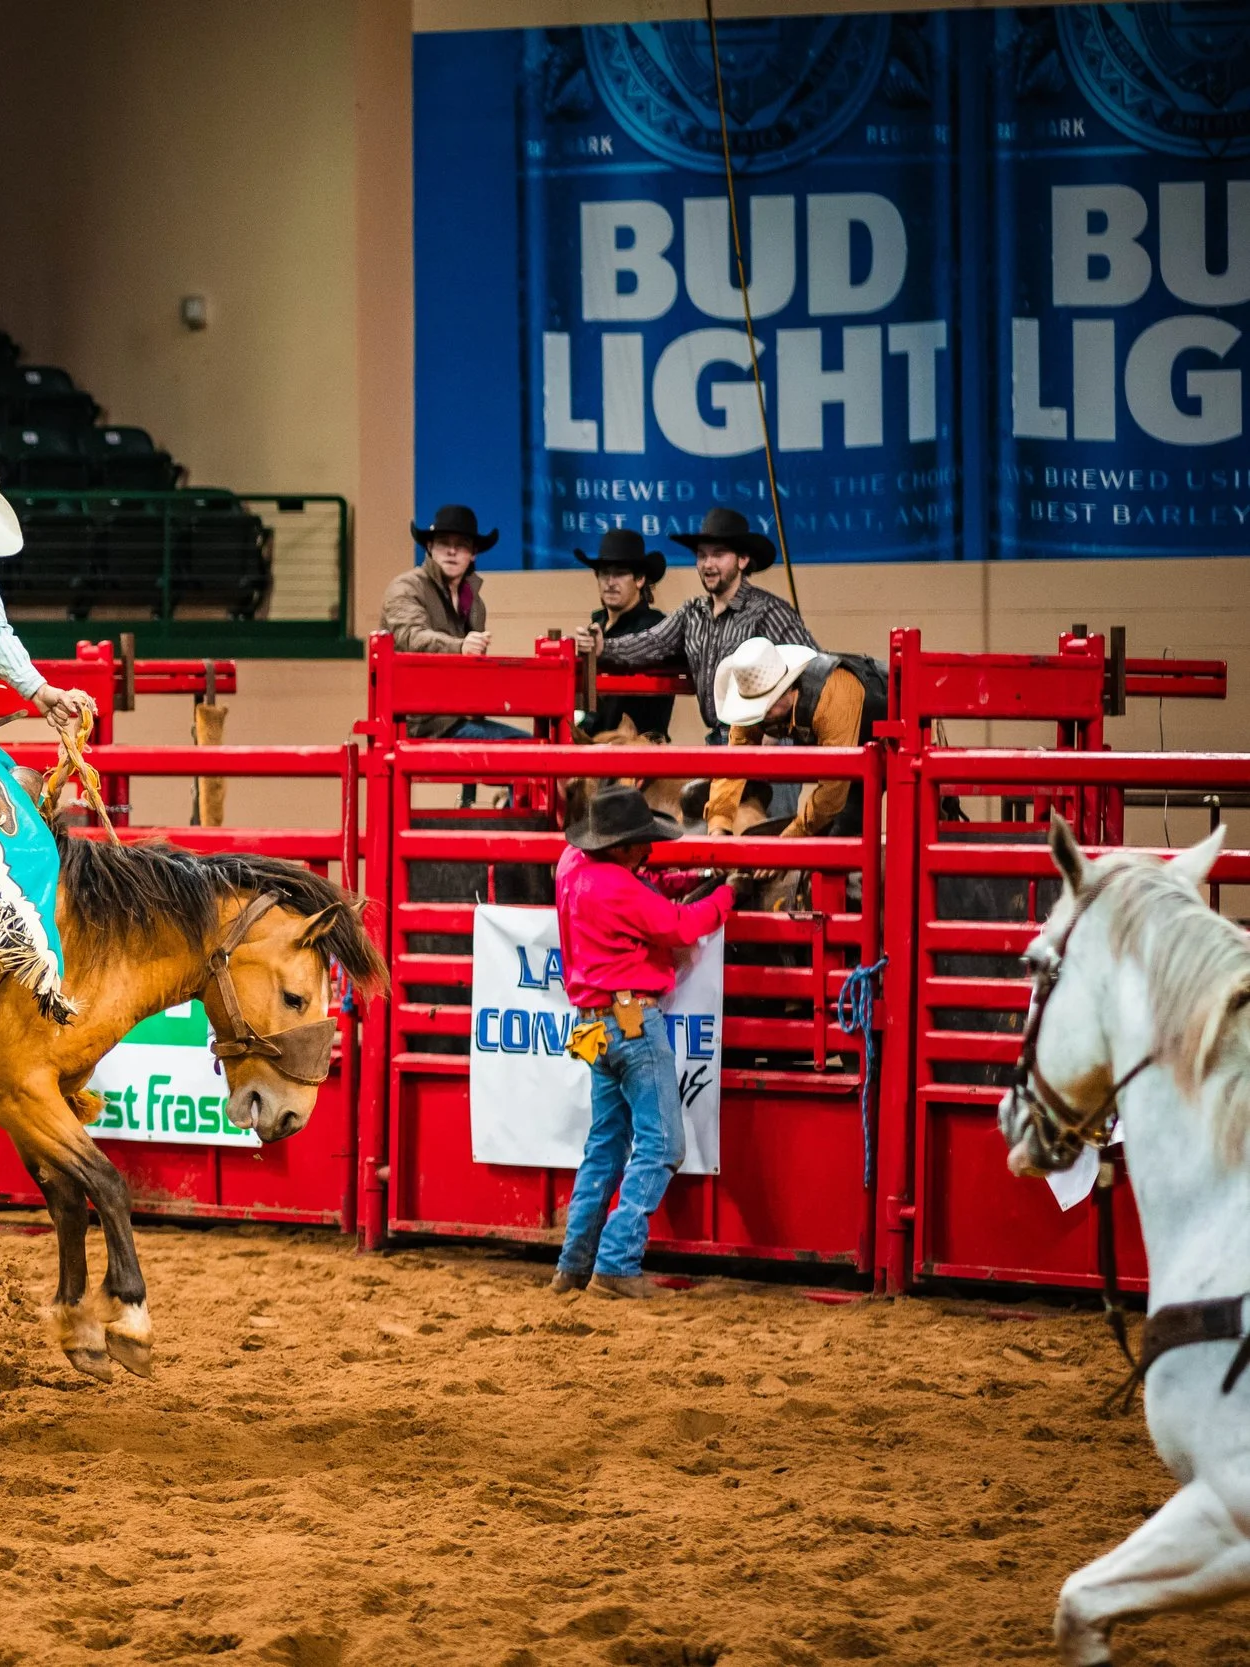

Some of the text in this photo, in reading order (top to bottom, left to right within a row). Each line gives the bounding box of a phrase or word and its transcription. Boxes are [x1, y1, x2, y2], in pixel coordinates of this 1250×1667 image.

[579, 193, 908, 322] BUD
[542, 319, 948, 458] LIGHT
[575, 477, 695, 502] BREWED
[711, 477, 816, 501] USING
[832, 472, 886, 498] THE
[1044, 466, 1170, 492] BREWED
[562, 511, 627, 534] BEST
[641, 513, 776, 537] BARY
[1030, 500, 1250, 527] BEST BARLEY
